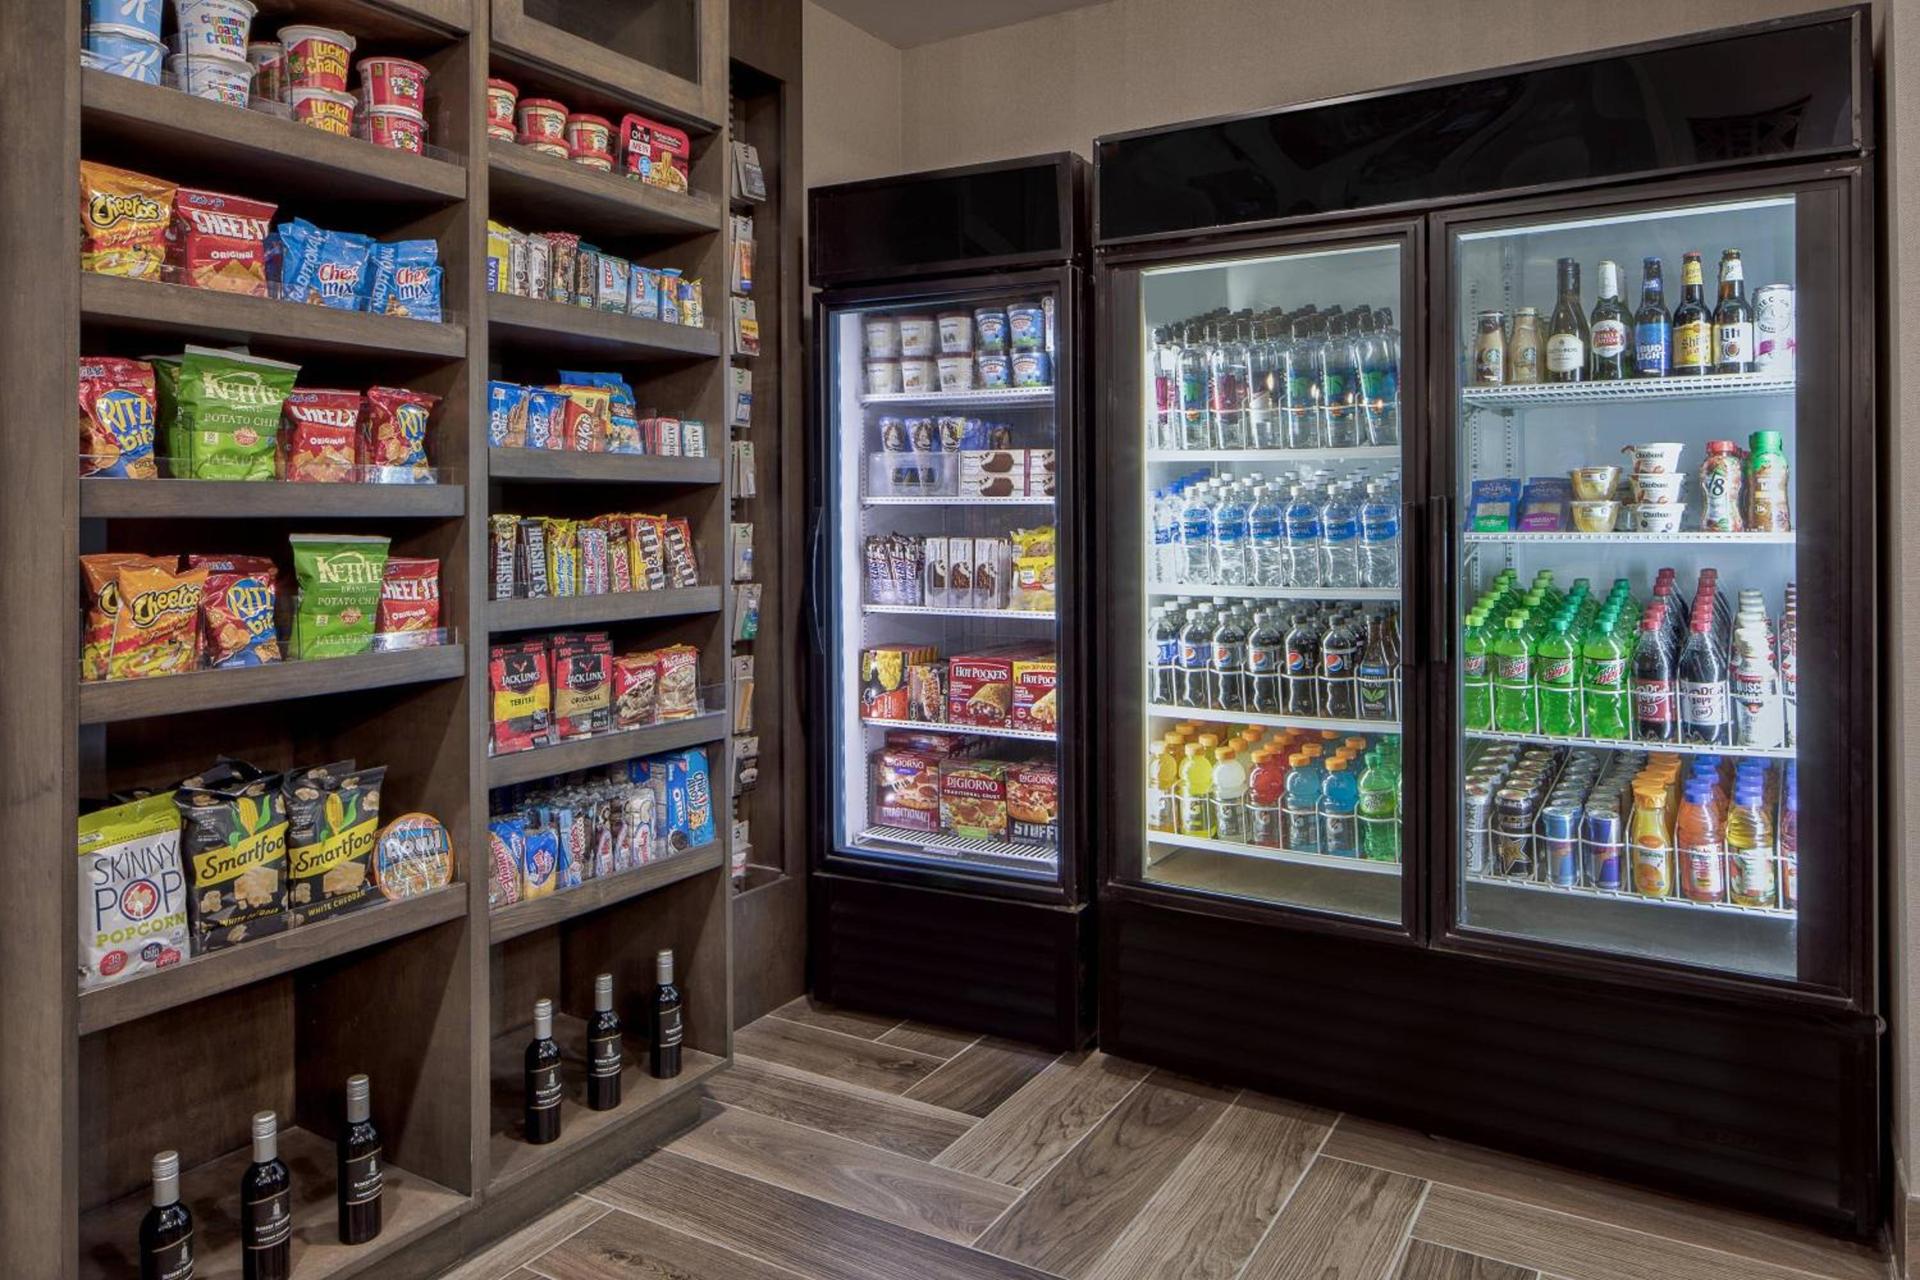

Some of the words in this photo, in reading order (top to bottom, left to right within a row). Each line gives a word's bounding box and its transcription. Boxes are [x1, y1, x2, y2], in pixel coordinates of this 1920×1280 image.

[90, 194, 161, 227] Cheetos
[319, 263, 360, 282] Chex
[395, 266, 429, 285] Chex
[487, 260, 497, 292] LUNA
[1637, 351, 1665, 361] LIGHT
[1640, 343, 1662, 353] BUD
[204, 412, 251, 425] POTATO
[383, 577, 439, 601] HEEZ-IT
[317, 596, 357, 606] POTATO
[955, 666, 972, 678] HOT
[972, 668, 1008, 680] POCKETS
[1023, 674, 1038, 684] HOT
[1014, 822, 1057, 839] STUFF
[94, 840, 178, 886] SKINNY
[201, 834, 285, 880] Smartfoo
[94, 870, 182, 932] POP
[95, 912, 186, 949] POPCORN
